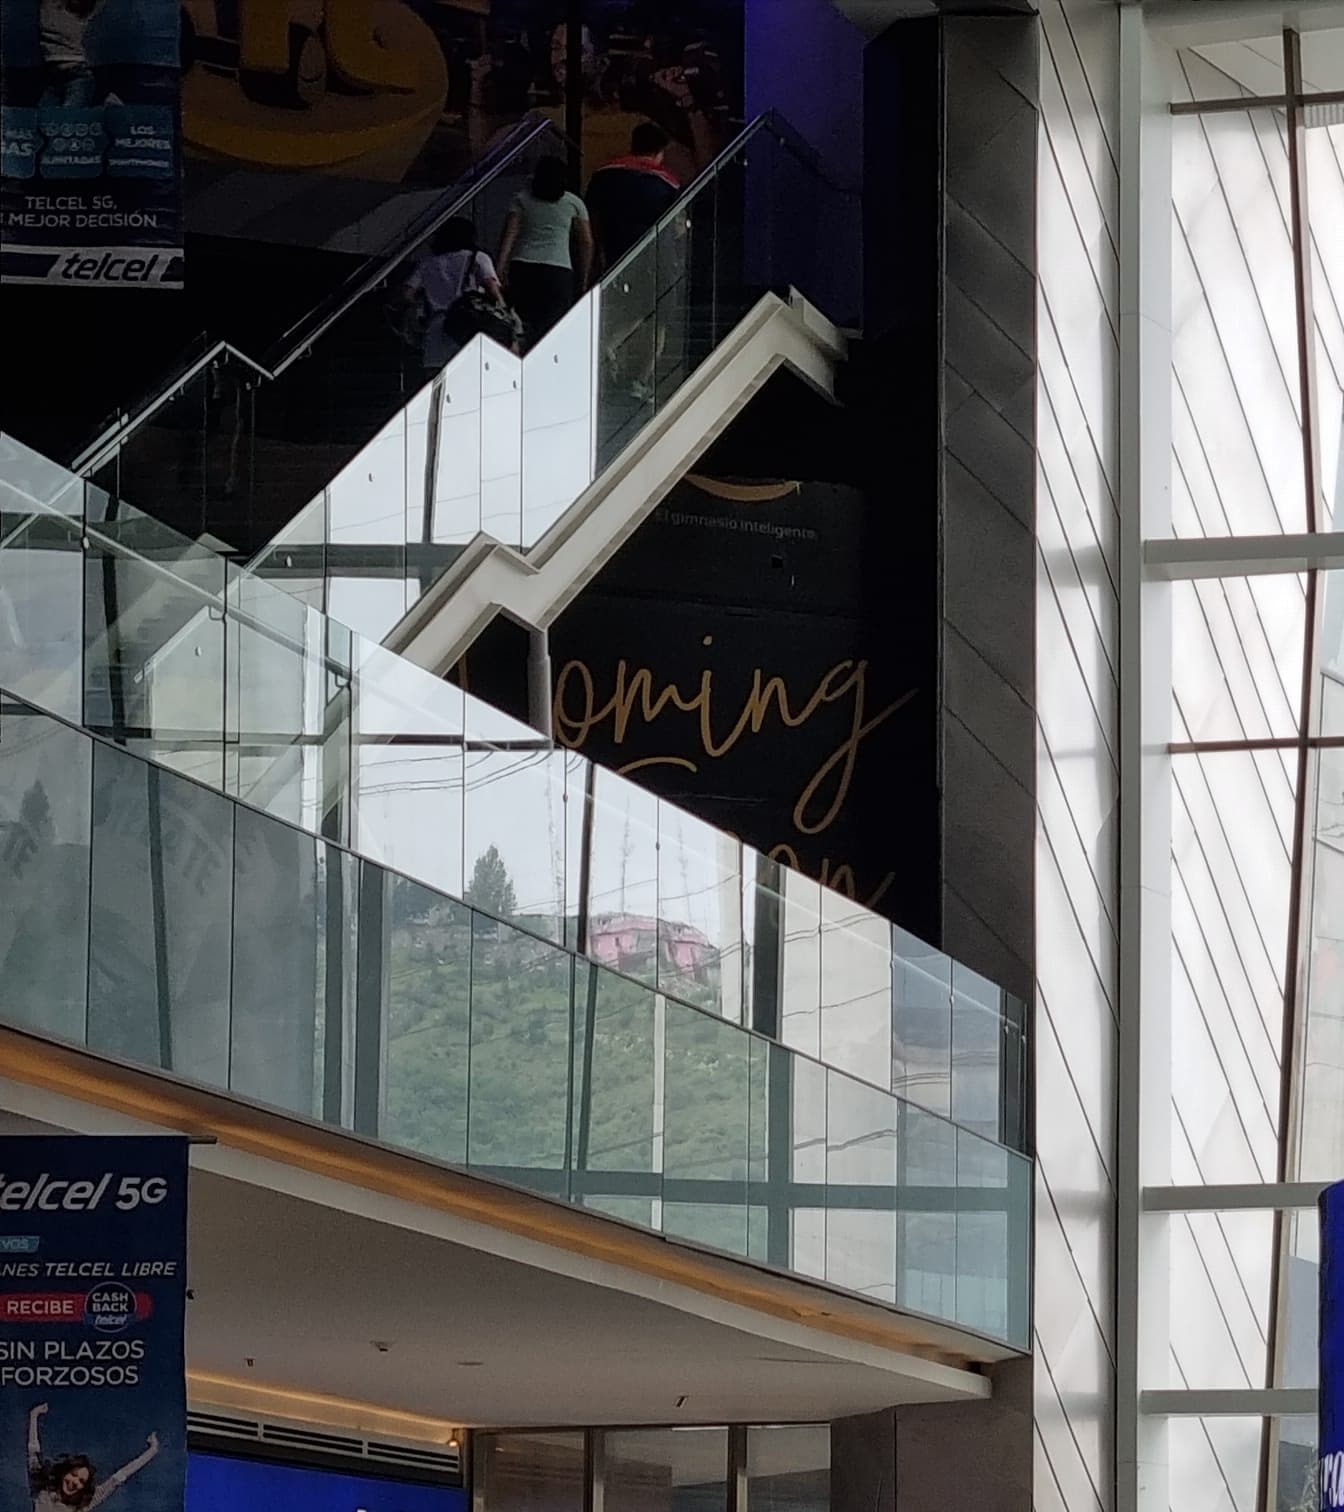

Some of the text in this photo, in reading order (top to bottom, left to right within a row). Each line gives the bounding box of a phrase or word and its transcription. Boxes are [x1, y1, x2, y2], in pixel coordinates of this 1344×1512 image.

[25, 195, 87, 210] TELCEL
[75, 209, 158, 228] DECISIÓN
[62, 252, 159, 281] telcel
[553, 635, 920, 834] oming
[114, 1175, 168, 1212] 5G
[45, 1261, 115, 1278] TELCEL
[121, 1260, 177, 1277] LIBRE
[91, 1291, 129, 1302] CASH
[7, 1299, 75, 1316] RECIBE
[91, 1302, 129, 1313] BACK
[45, 1339, 145, 1360] PLAZOS
[1, 1364, 140, 1387] FORZOSOS
